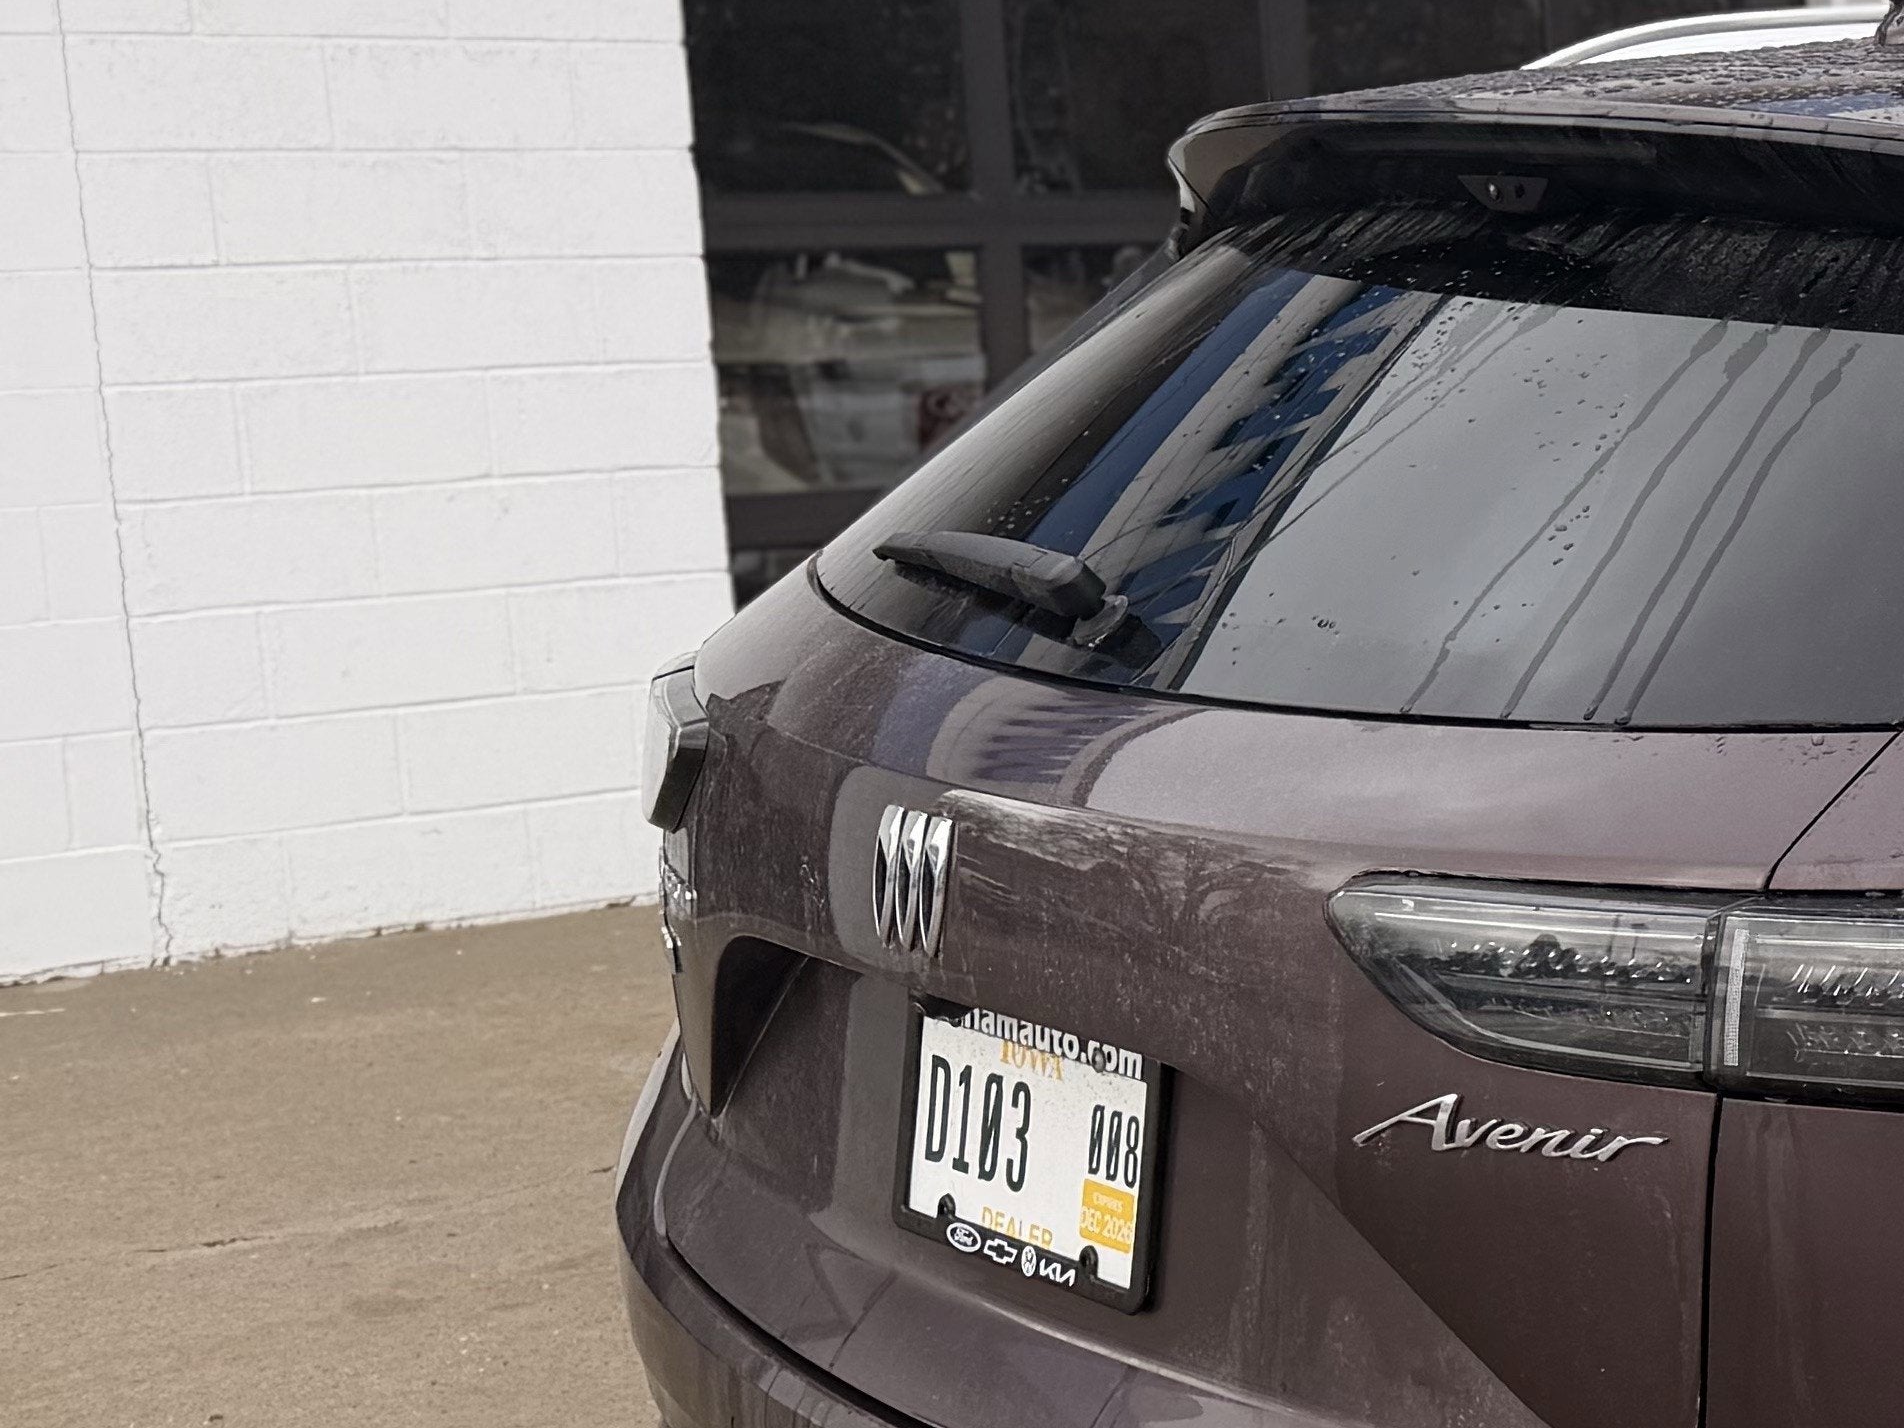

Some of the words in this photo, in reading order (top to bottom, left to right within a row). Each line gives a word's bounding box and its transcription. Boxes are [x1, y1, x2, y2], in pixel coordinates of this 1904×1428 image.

[924, 1054, 1032, 1193] D103
[1087, 1103, 1141, 1189] 008
[1353, 1093, 1670, 1162] Avenir
